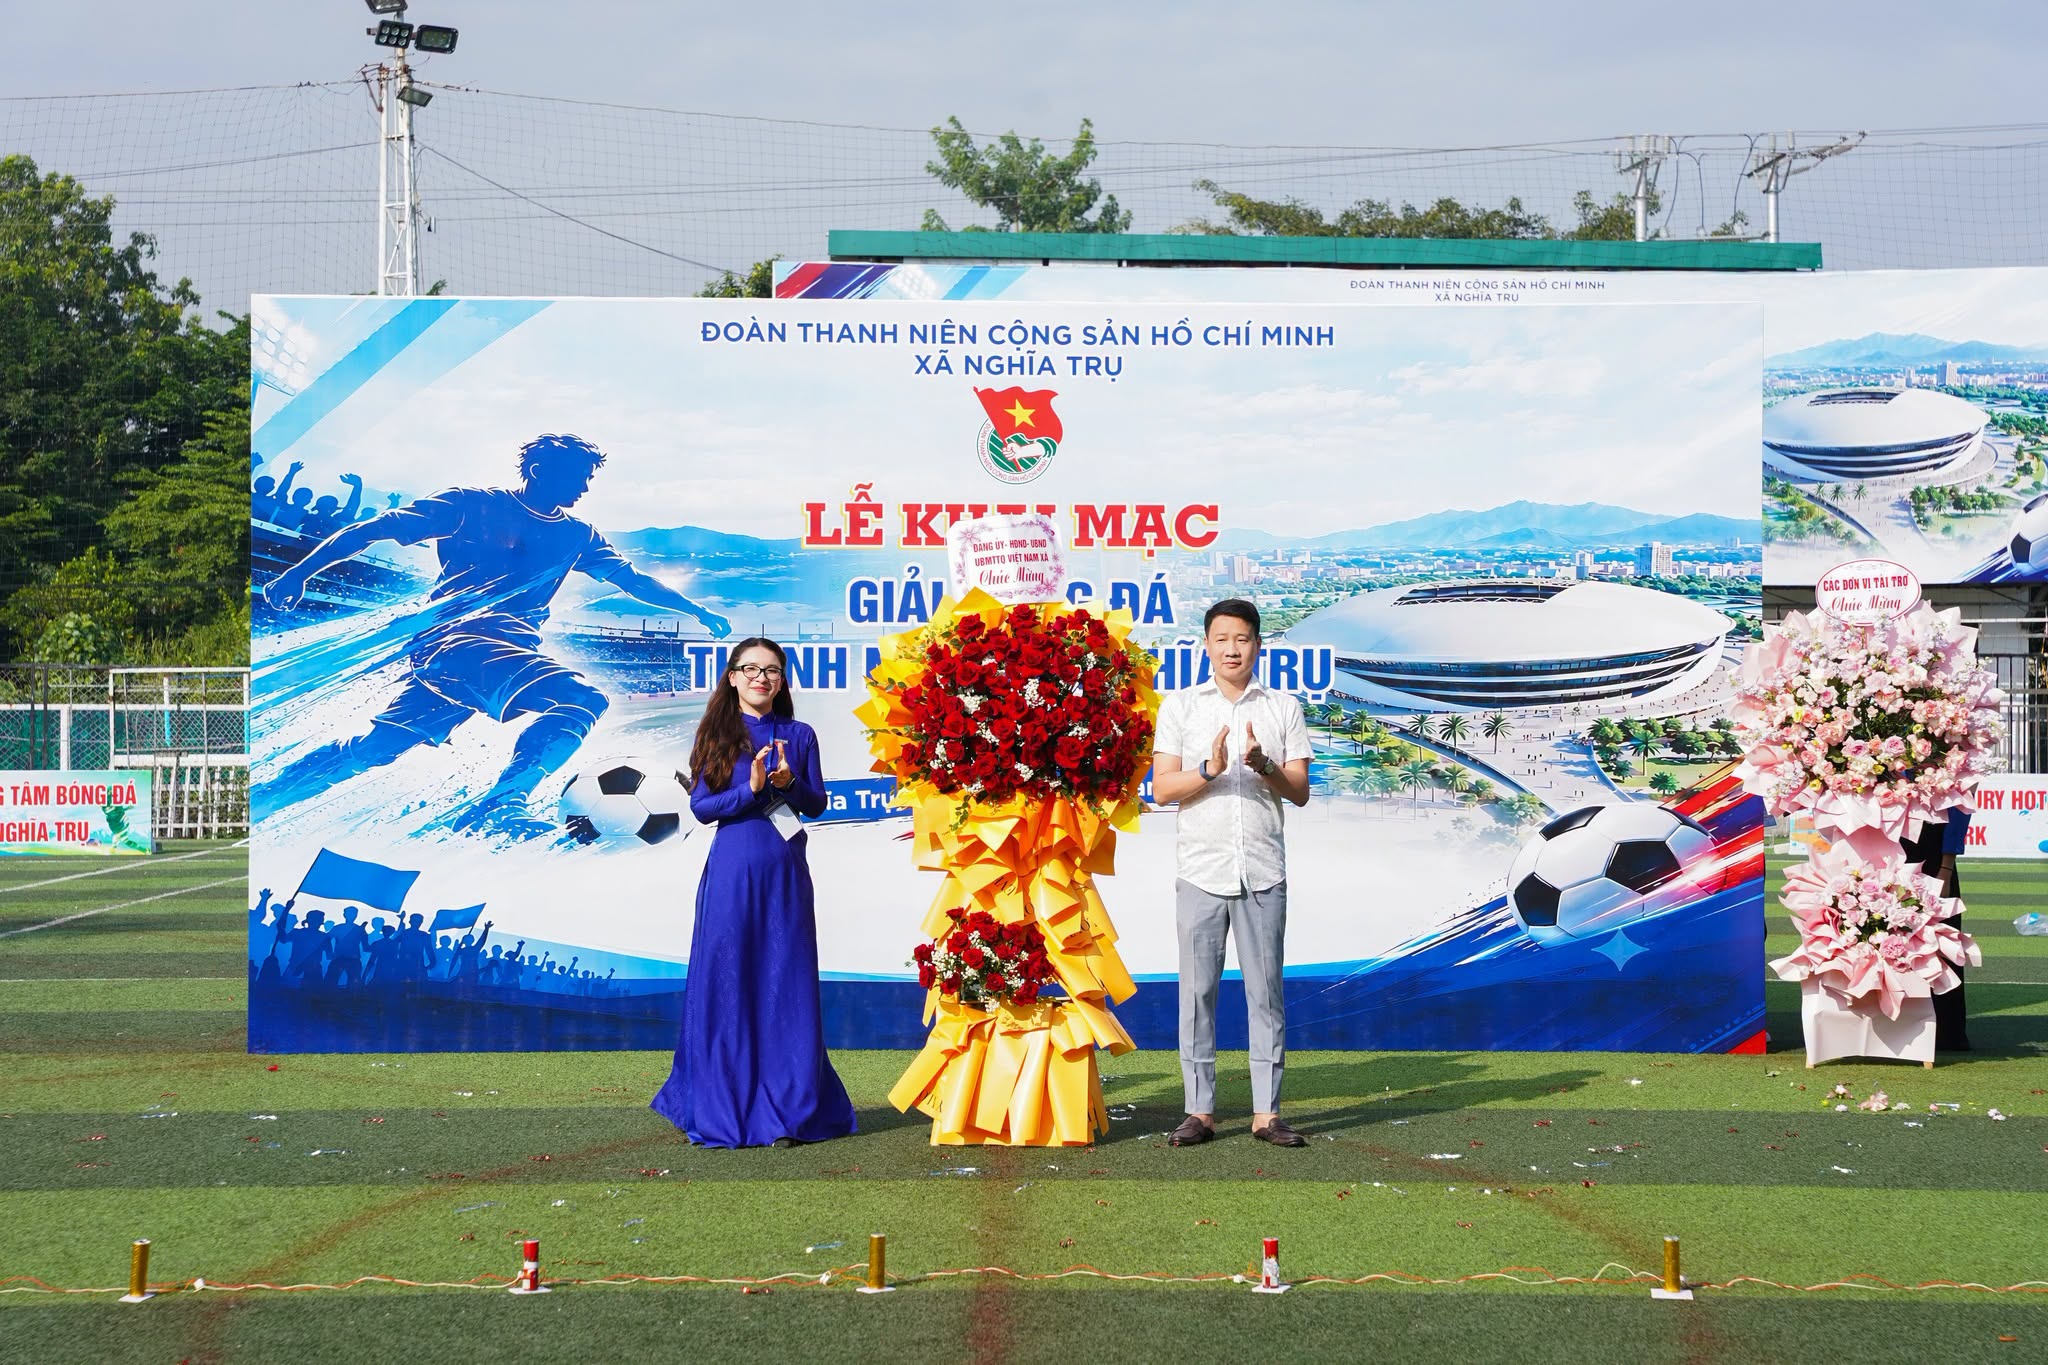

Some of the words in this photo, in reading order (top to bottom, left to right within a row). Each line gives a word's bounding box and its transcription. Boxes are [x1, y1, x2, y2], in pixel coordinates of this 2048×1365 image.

[1388, 280, 1429, 290] THANH
[1432, 278, 1460, 290] NIÊN
[1575, 280, 1605, 290] MINH
[701, 316, 787, 342] ĐOÀN
[797, 323, 898, 343] THANH
[909, 319, 977, 345] NIÊN
[988, 319, 1072, 350] CỘNG
[1082, 318, 1140, 345] SẢN
[1151, 317, 1193, 345] HỒ
[1203, 320, 1251, 345] CHÍ
[1262, 326, 1334, 346] MINH
[914, 350, 954, 375] XÃ
[964, 350, 1056, 376] NGHĨA
[1067, 356, 1123, 382] TRỤ
[805, 482, 883, 545] LỄ
[1074, 504, 1219, 558] MẠC
[974, 555, 1006, 567] UBMTTQ
[1023, 553, 1039, 562] NAM
[1109, 572, 1174, 624] ĐÁ
[10, 782, 49, 806] TÂM
[56, 781, 106, 805] BÓNG
[112, 781, 137, 805] ĐÁ
[55, 822, 89, 846] TRỤ
